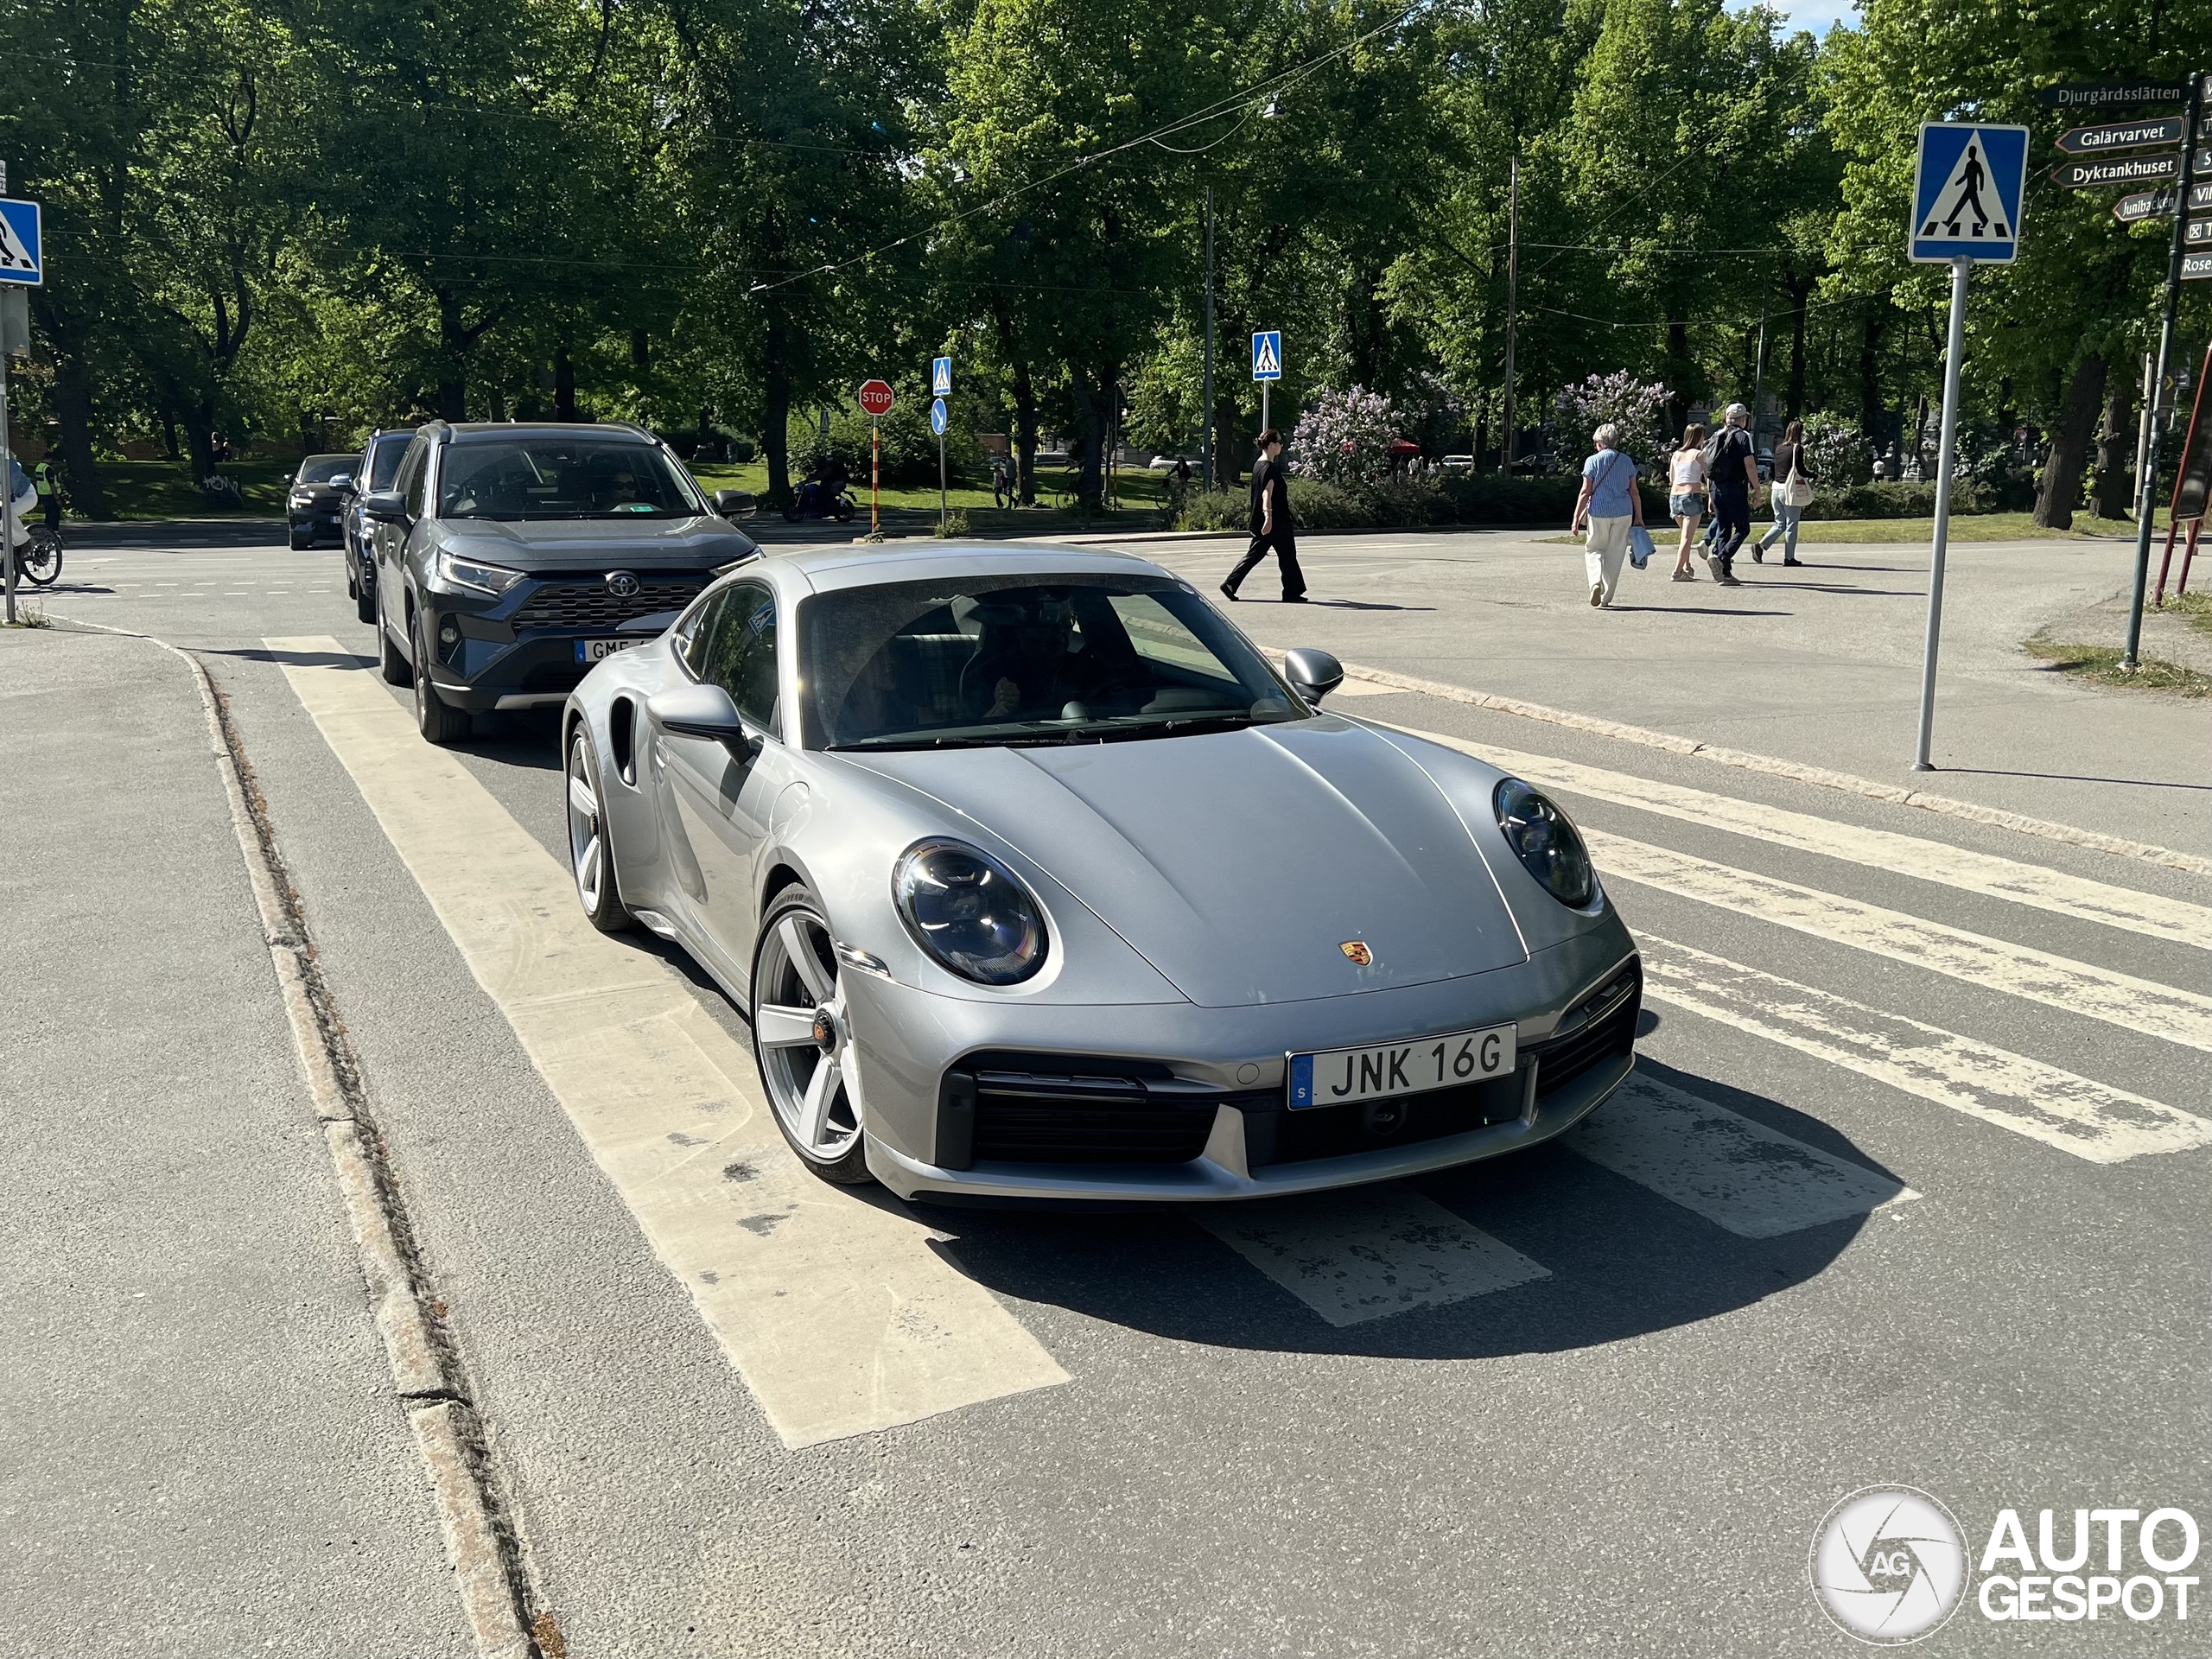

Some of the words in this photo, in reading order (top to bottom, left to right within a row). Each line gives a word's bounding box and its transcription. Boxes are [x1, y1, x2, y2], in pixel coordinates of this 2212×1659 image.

[2058, 87, 2181, 105] Djurgårdsslätten
[2081, 126, 2165, 146] Galärvarvet
[2074, 159, 2174, 184] Dyktankhuset
[2122, 196, 2175, 217] Junibacken
[2183, 259, 2212, 272] Rose
[862, 391, 891, 404] STOP
[1332, 1048, 1410, 1096] JNK
[1431, 1033, 1501, 1082] 16G
[1297, 1087, 1306, 1099] S
